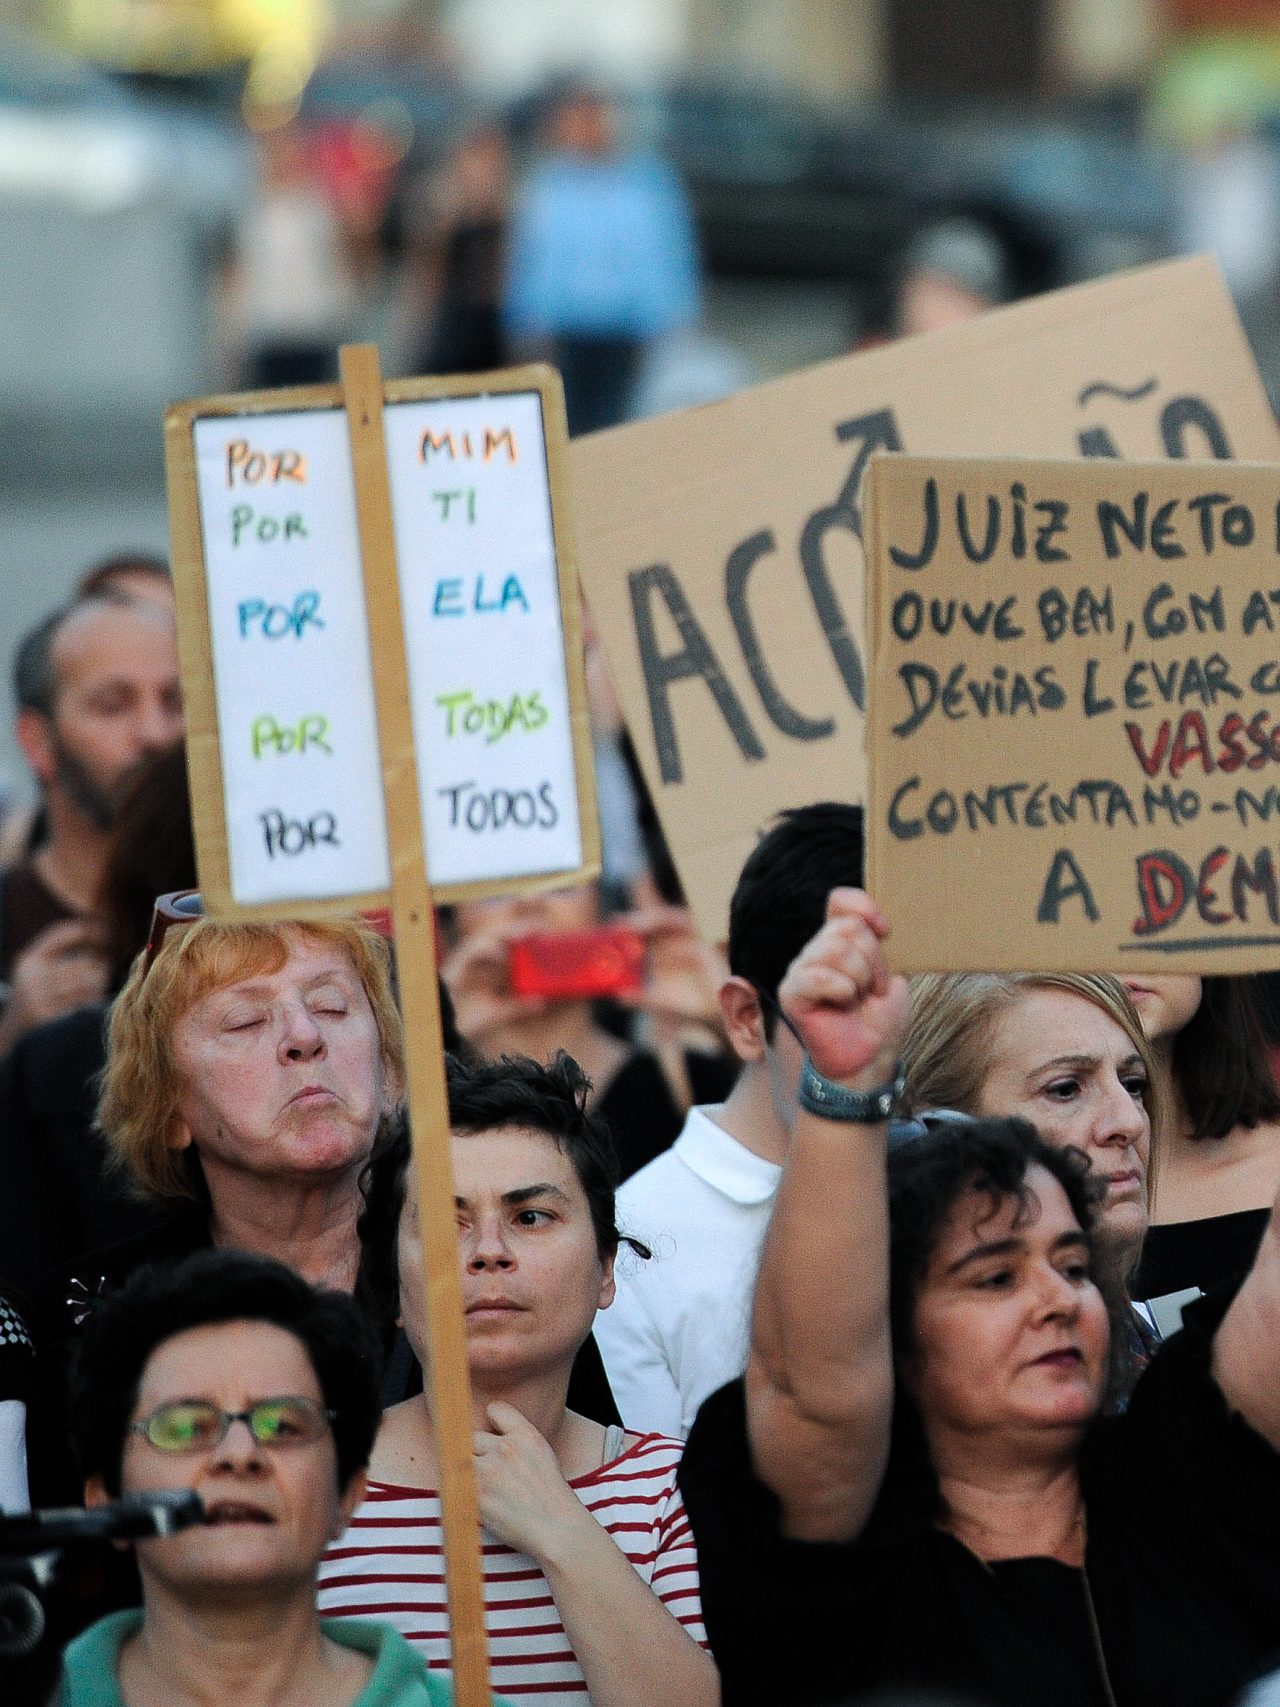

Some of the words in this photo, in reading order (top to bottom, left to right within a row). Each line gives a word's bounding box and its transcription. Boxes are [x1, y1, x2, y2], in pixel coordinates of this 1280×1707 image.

[225, 438, 307, 488] POR
[418, 426, 518, 465] MIM
[232, 505, 309, 549] POR
[432, 488, 478, 525] TI
[1097, 491, 1256, 559] NETO
[238, 591, 326, 639] POR
[432, 574, 530, 618] ELA
[891, 588, 1025, 642] OUVE
[1038, 585, 1133, 653] BEM,
[1143, 582, 1225, 640] COM
[1084, 654, 1243, 718] LEVAR
[251, 714, 334, 760] POR
[436, 690, 550, 744] TODAS
[258, 808, 341, 861] POR
[439, 781, 559, 833] TODOS
[1036, 847, 1101, 924] A
